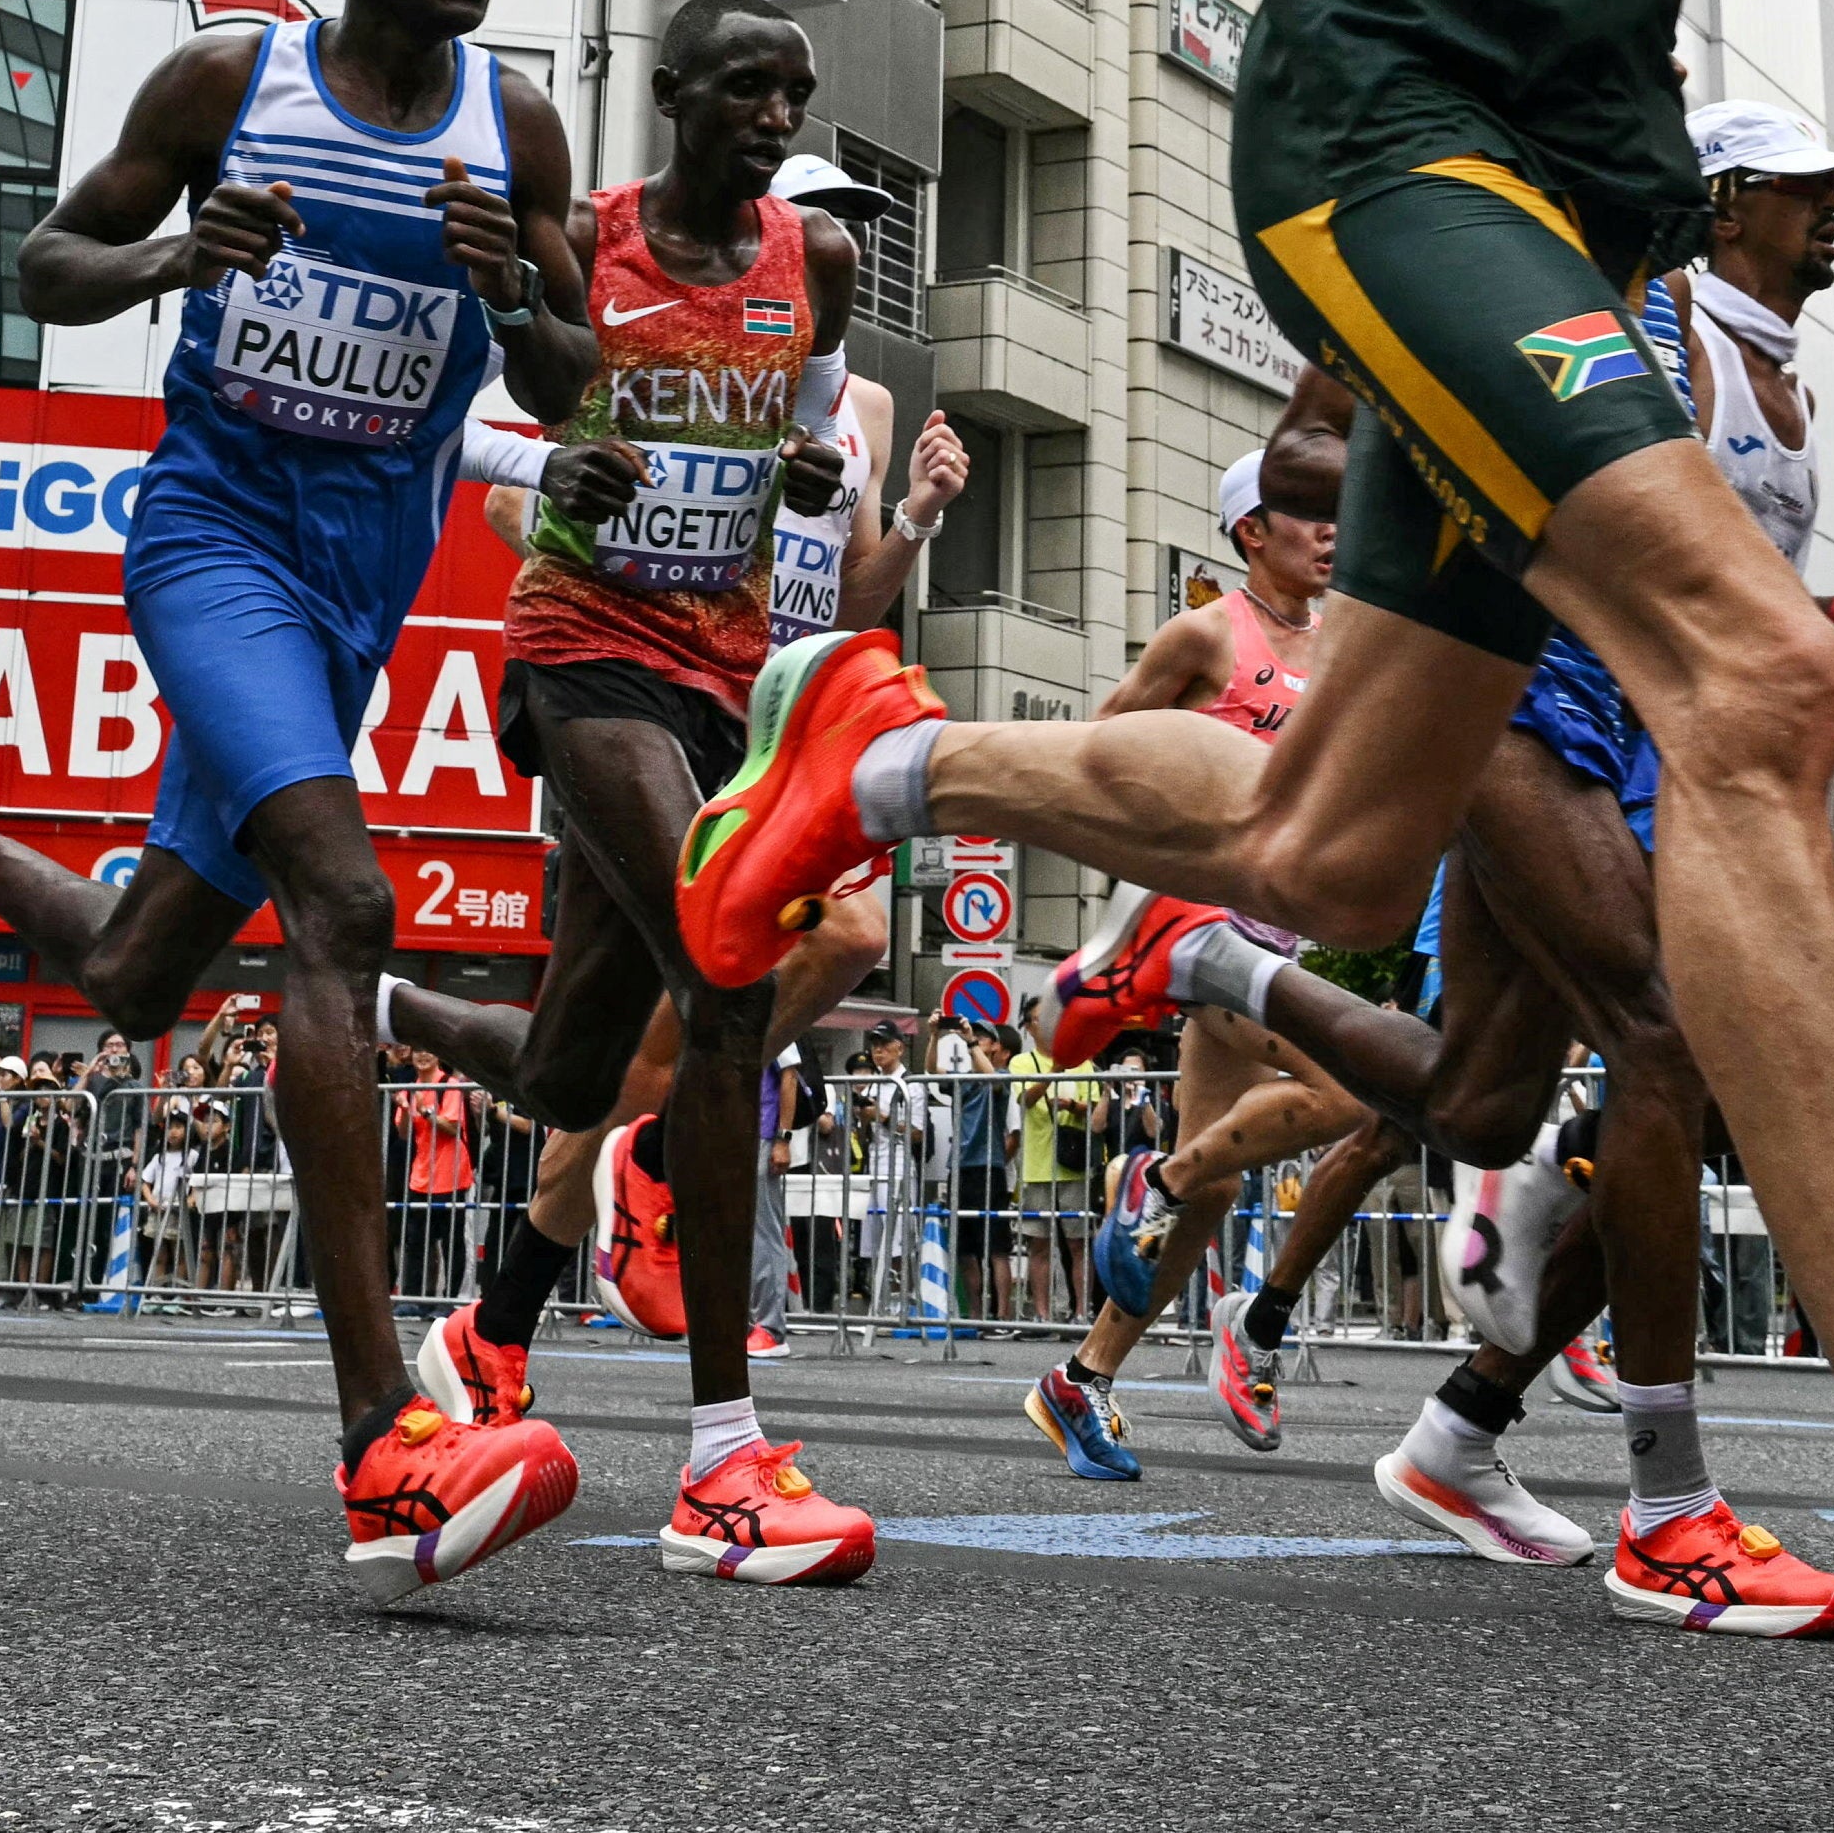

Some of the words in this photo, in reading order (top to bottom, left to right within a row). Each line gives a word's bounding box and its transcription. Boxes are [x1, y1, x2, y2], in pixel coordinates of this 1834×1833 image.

[307, 266, 450, 342] TDK
[1171, 274, 1181, 320] 4F
[231, 317, 432, 402] PAULUS
[610, 367, 789, 426] KENYA
[668, 450, 769, 499] TDK
[773, 527, 840, 578] TDK
[413, 859, 531, 931] 2号館
